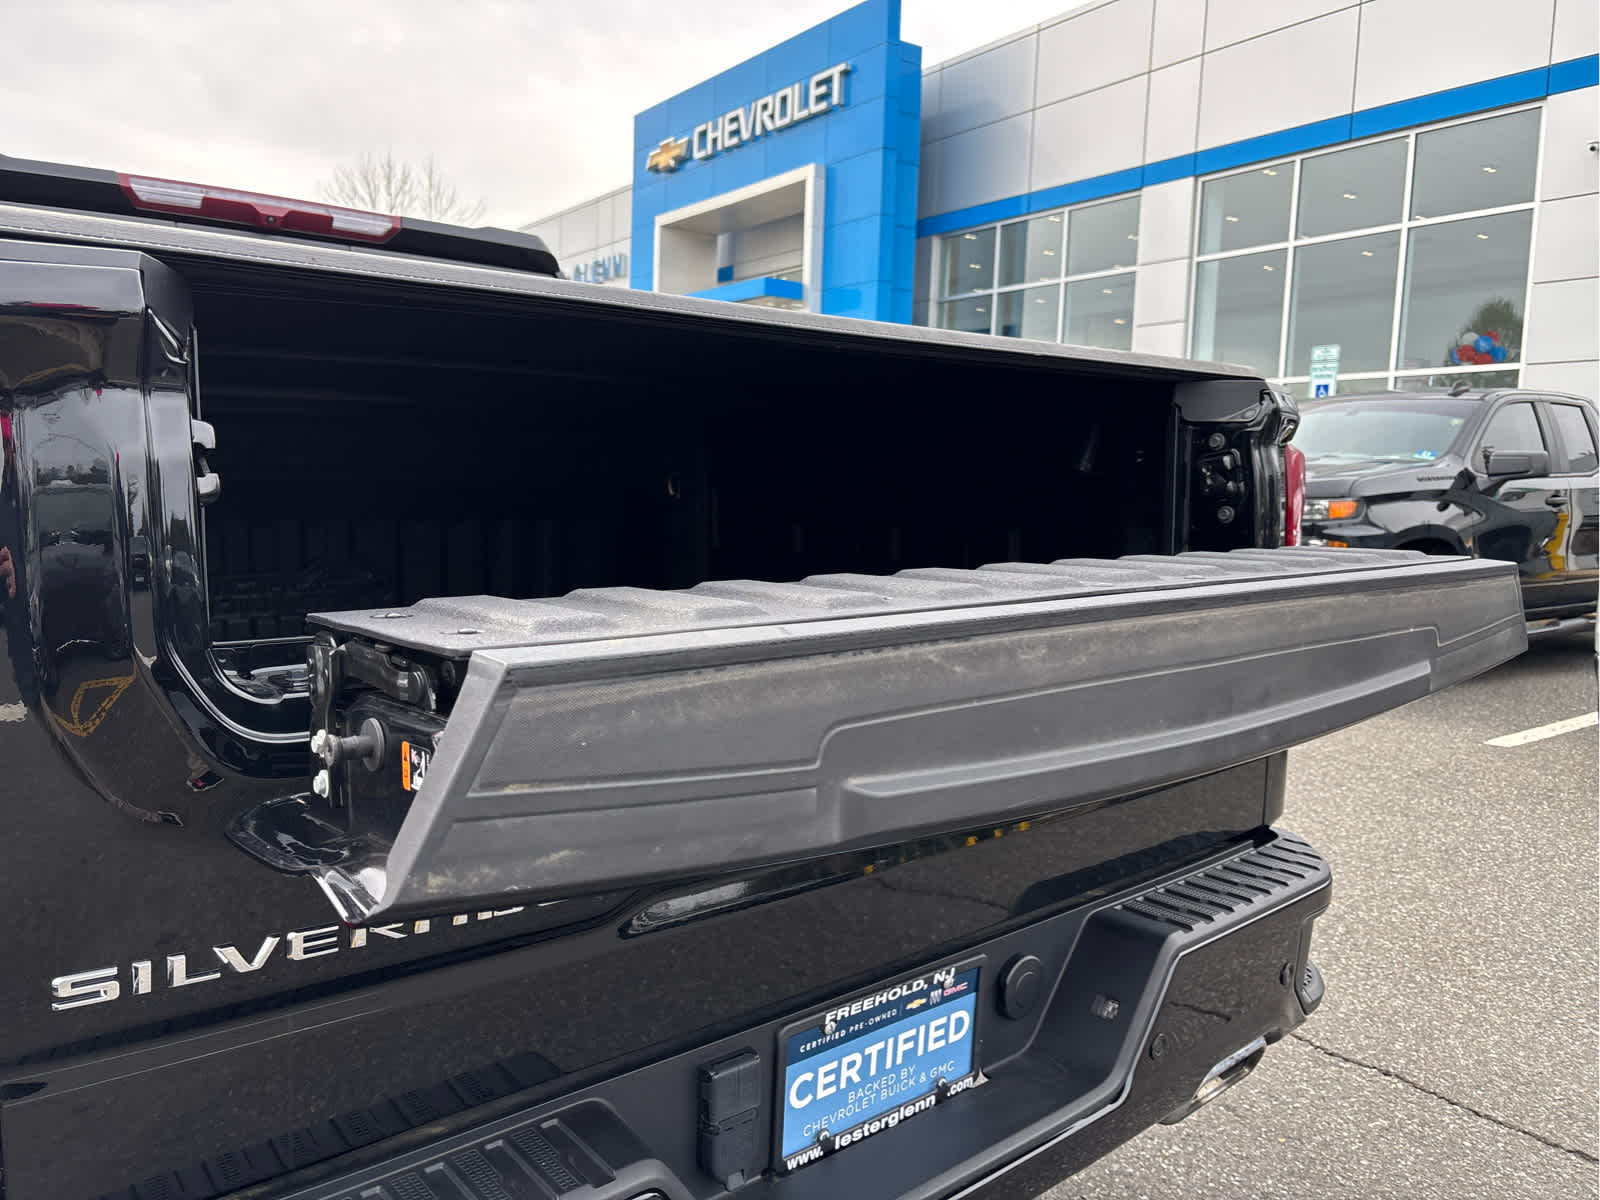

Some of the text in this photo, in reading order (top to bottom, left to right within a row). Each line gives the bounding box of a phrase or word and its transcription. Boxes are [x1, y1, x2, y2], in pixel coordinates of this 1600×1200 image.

[692, 62, 849, 160] CHEVROLET
[51, 898, 569, 1011] SILVER
[800, 1009, 897, 1053] CERTIFIED PRE-OWNED
[824, 979, 928, 1024] FREEHOLD,
[789, 1010, 970, 1109] CERTIFIED
[848, 1064, 916, 1104] BACKED BY
[803, 1060, 955, 1137] CHEVROLET BUICK & GMC
